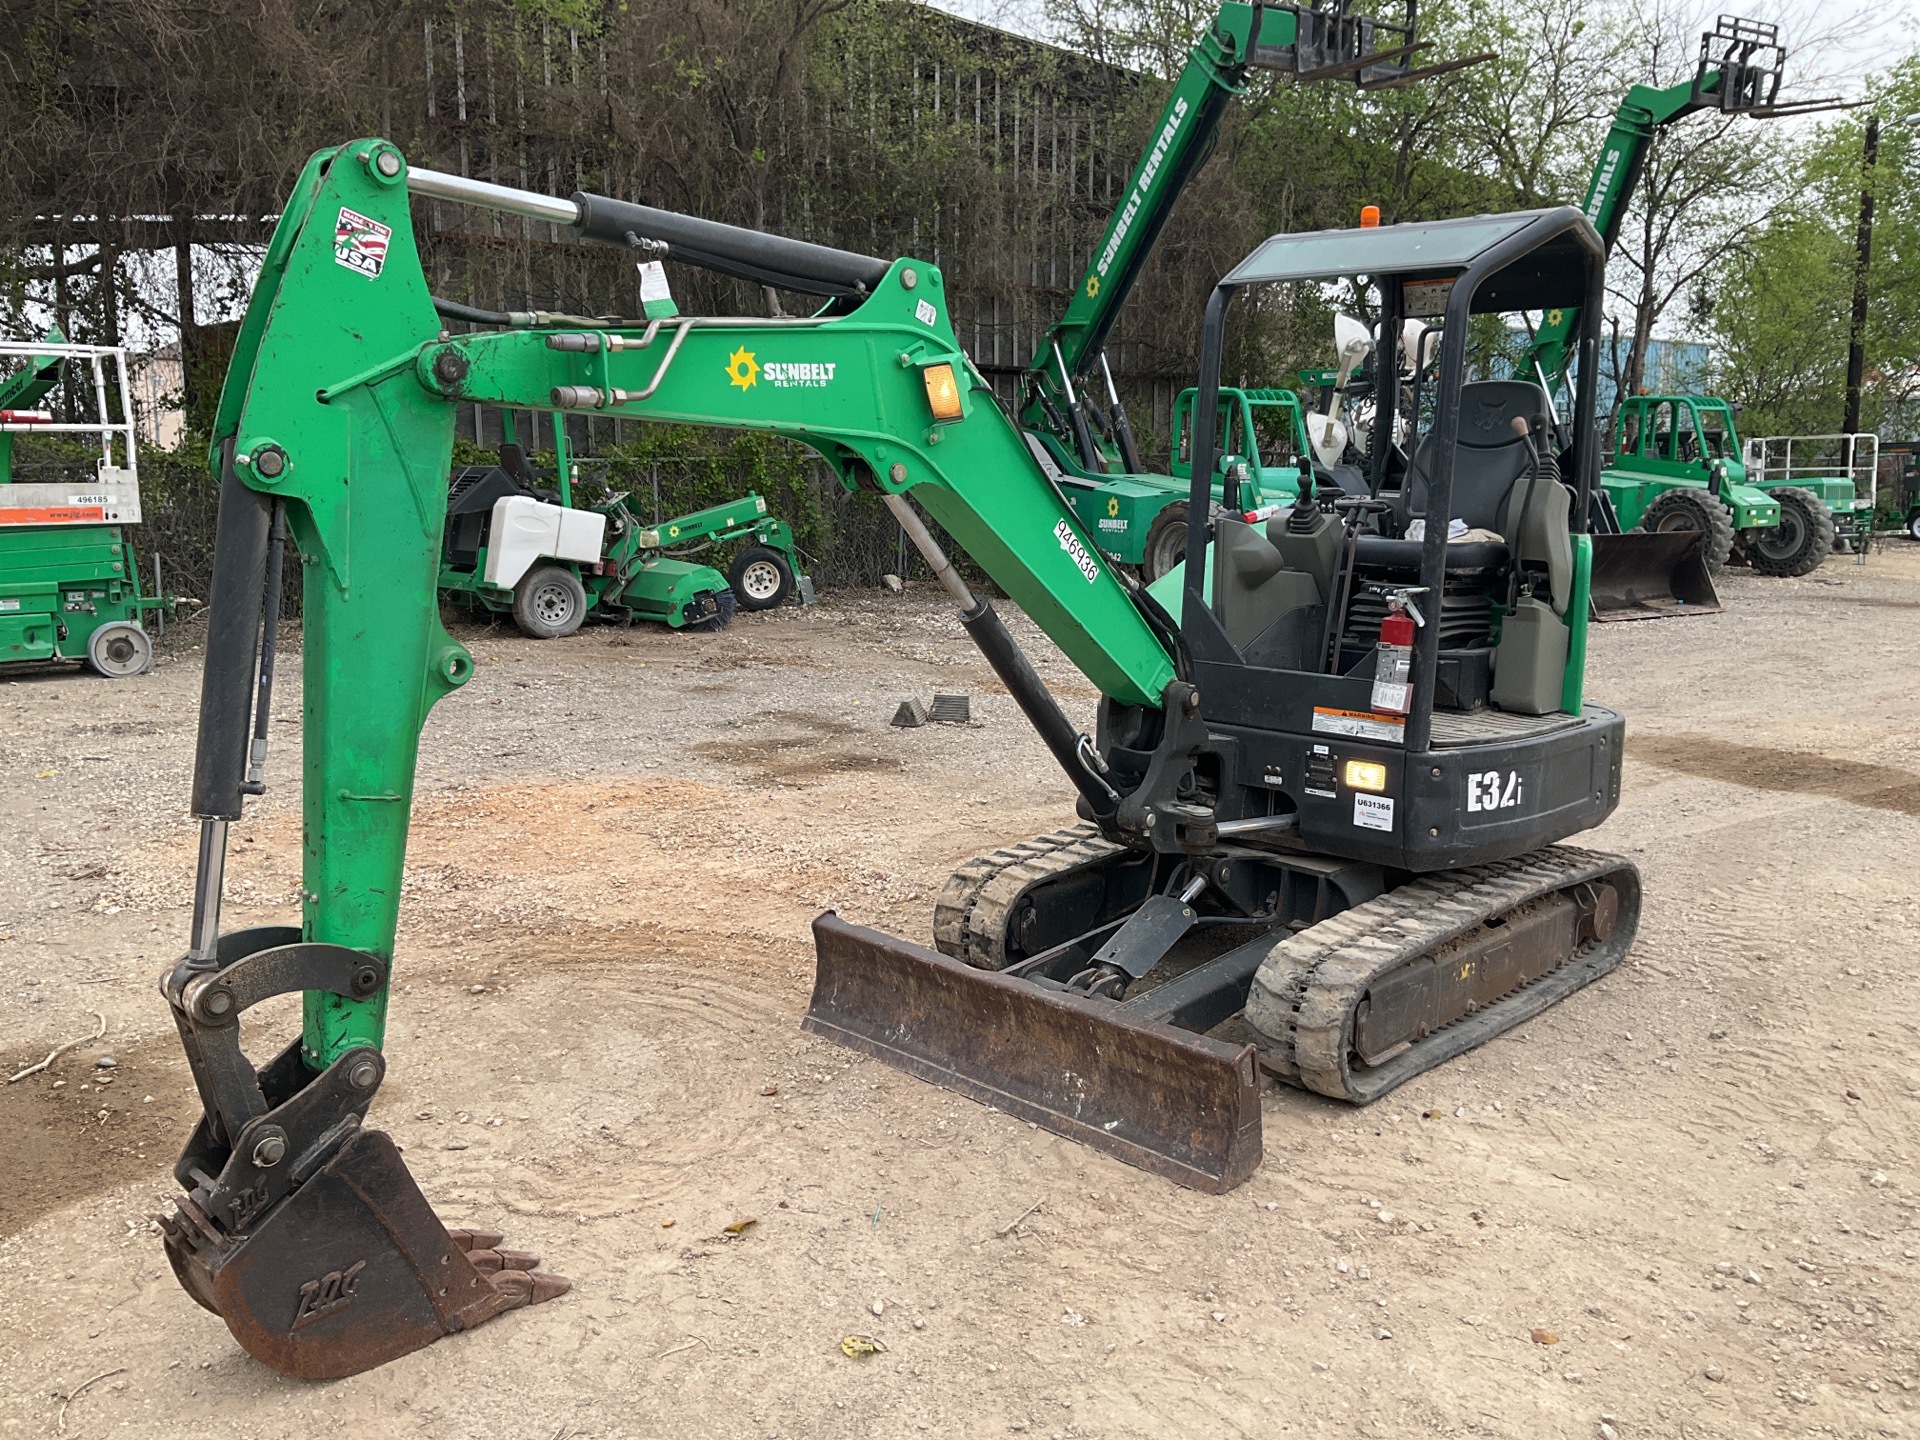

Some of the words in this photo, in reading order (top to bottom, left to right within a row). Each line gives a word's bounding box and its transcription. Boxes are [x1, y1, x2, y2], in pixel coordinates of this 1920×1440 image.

[1097, 188, 1142, 277] SUNBELT
[1138, 97, 1188, 192] RENTALS
[374, 225, 388, 235] THE
[334, 246, 377, 273] USA
[763, 362, 836, 381] SUNBELT
[774, 380, 827, 388] RENTALS
[77, 495, 109, 504] 496185
[1098, 518, 1128, 529] SUNBELT
[1058, 520, 1098, 581] 946936
[1349, 712, 1376, 720] WARNING
[1357, 798, 1391, 811] U631366
